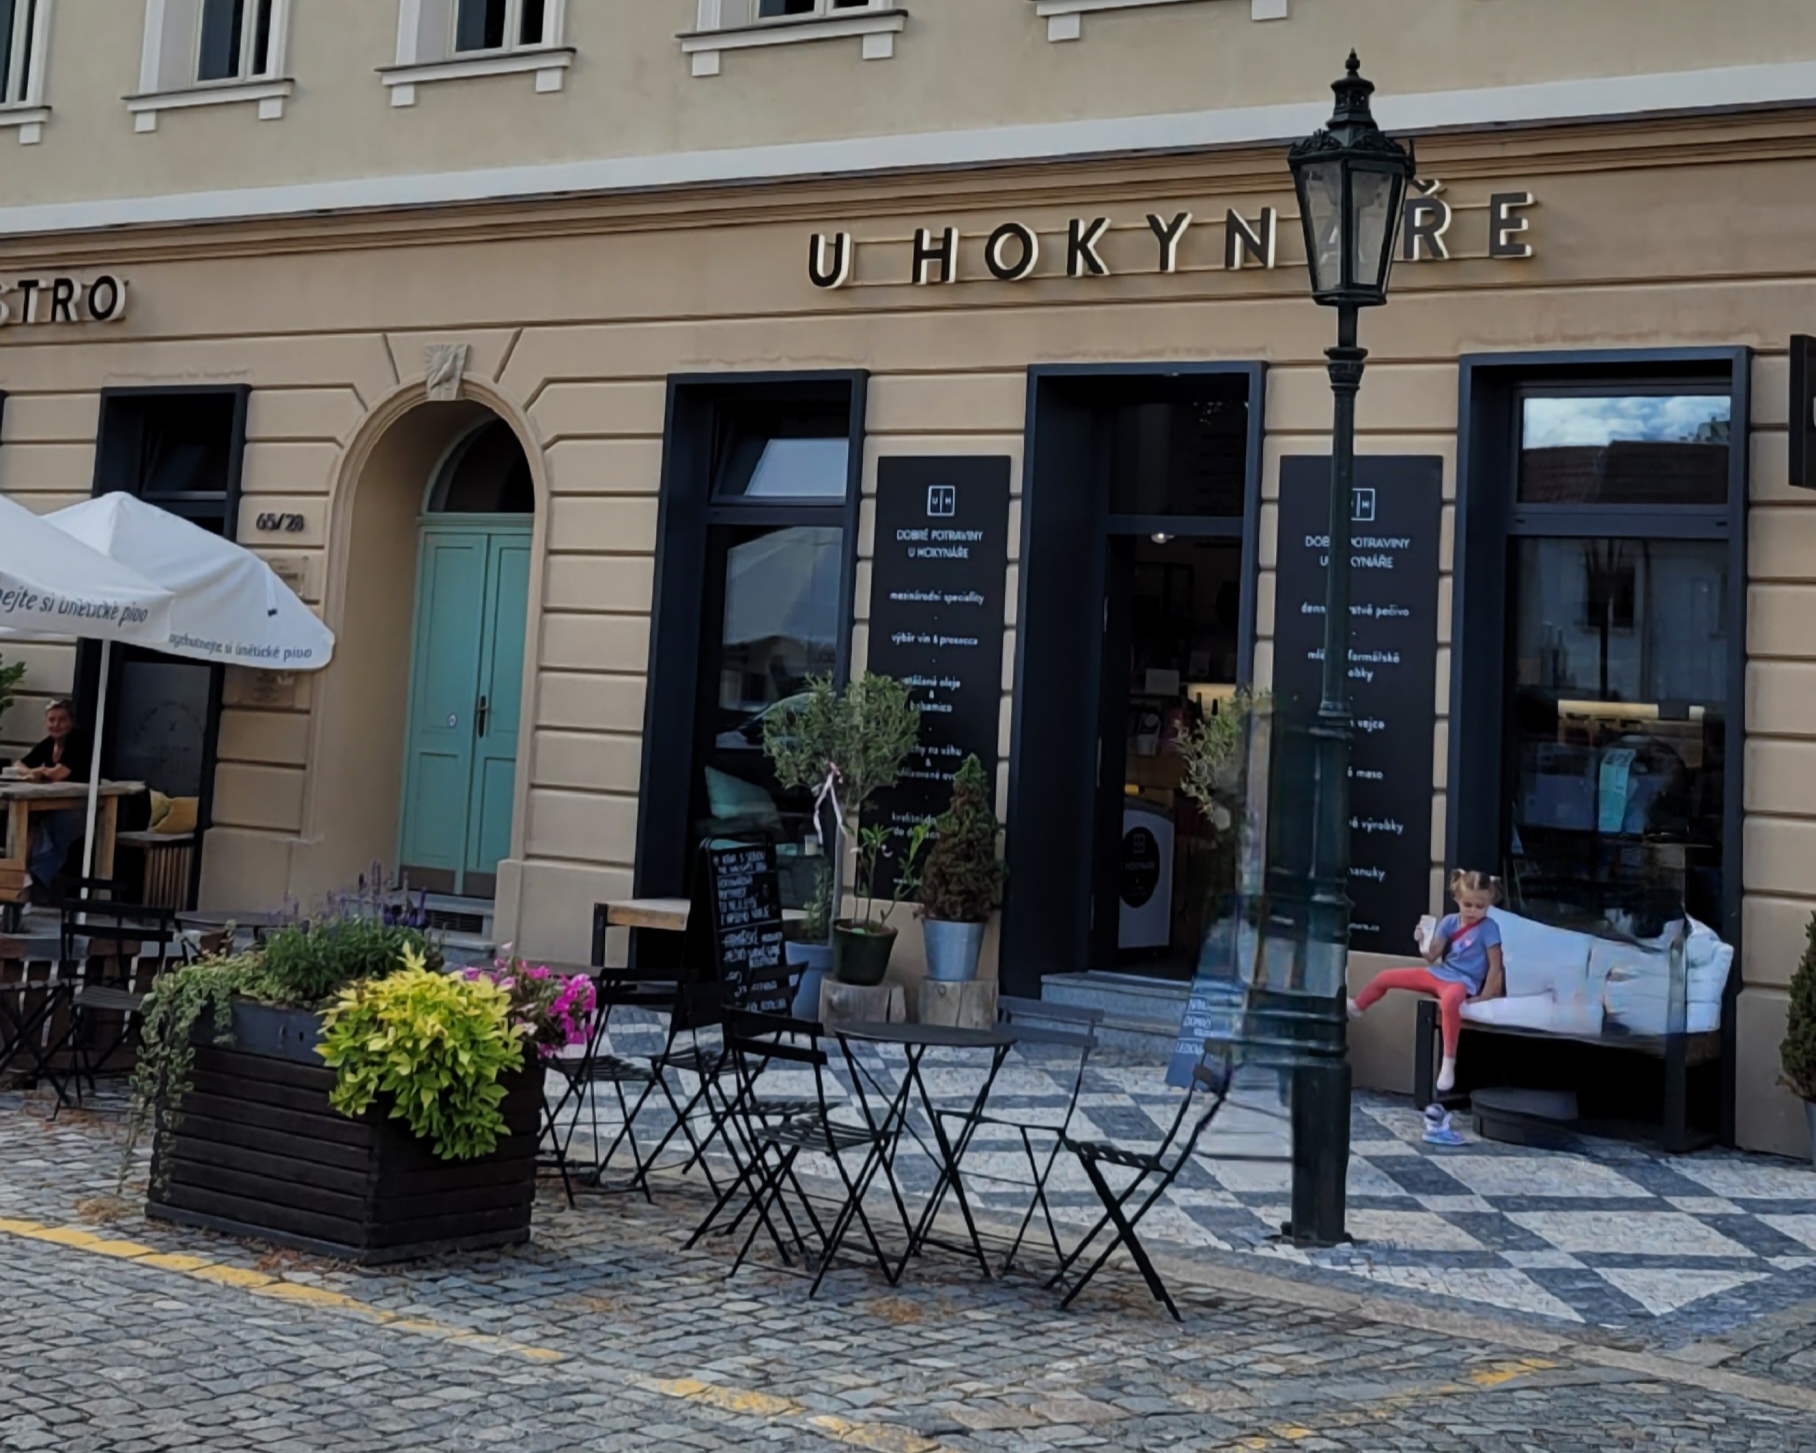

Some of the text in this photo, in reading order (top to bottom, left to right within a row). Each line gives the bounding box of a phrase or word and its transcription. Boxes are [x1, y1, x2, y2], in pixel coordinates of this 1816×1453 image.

[808, 232, 850, 289] U
[0, 275, 126, 325] TRO
[896, 528, 983, 542] DOBRÉ POTRAVINY
[1305, 535, 1330, 547] DOB
[0, 585, 38, 613] ejte
[1375, 604, 1410, 619] pečivo
[1361, 817, 1404, 835] výrobky
